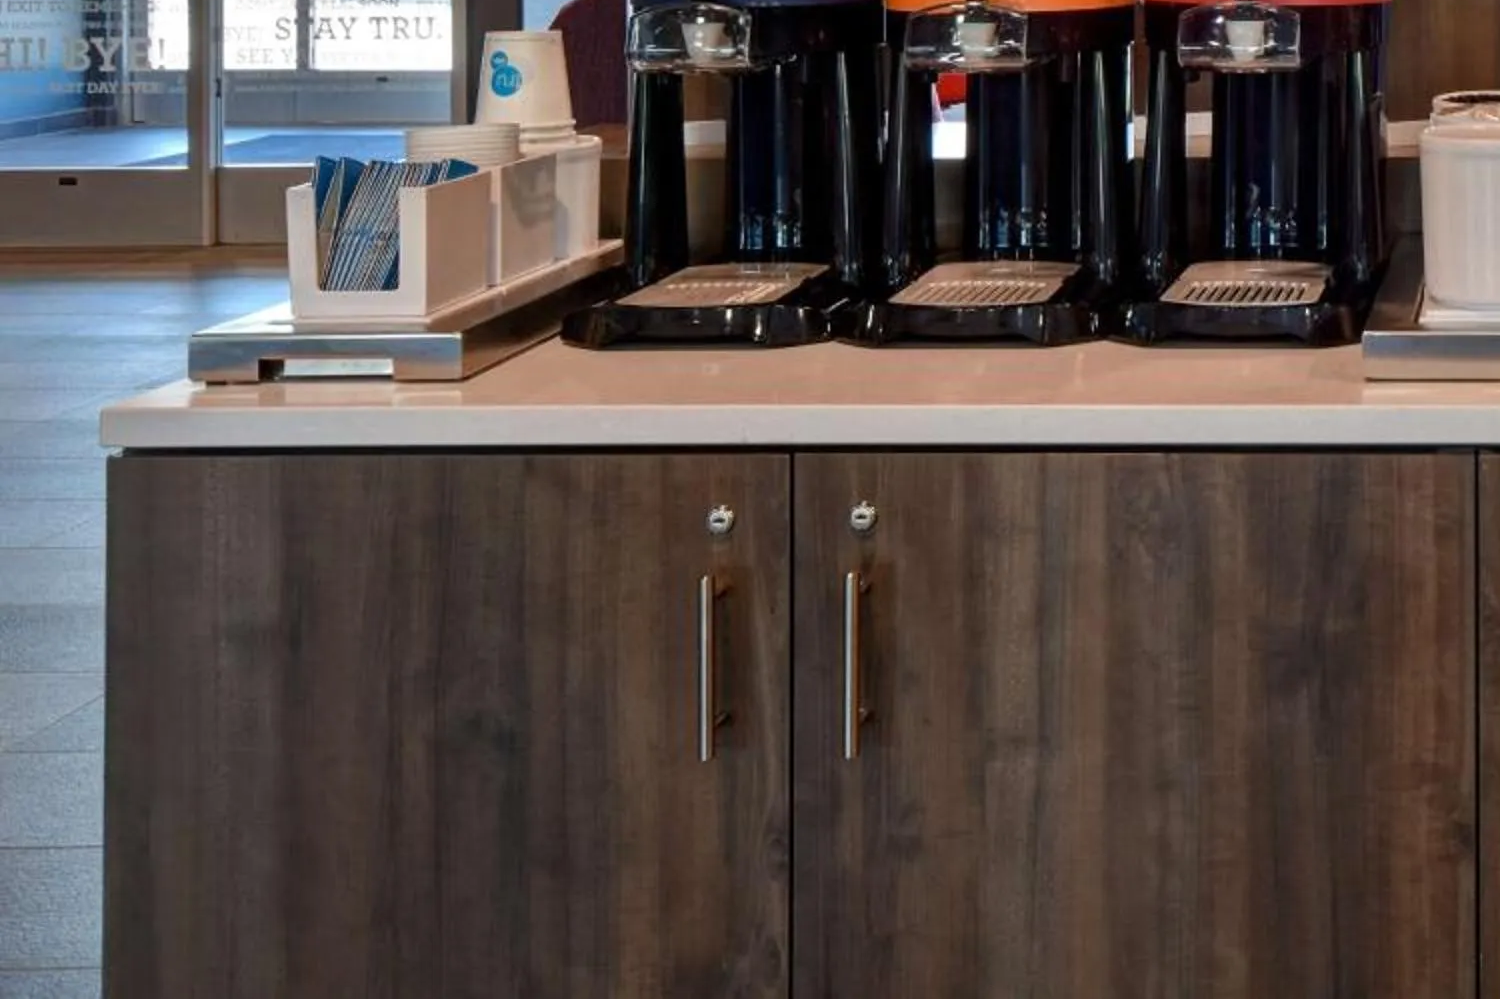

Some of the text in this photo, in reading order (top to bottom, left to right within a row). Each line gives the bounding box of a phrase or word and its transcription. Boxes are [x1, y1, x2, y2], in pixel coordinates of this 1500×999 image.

[368, 15, 444, 41] TRU.
[63, 36, 167, 72] BYE!
[87, 81, 118, 94] DAY
